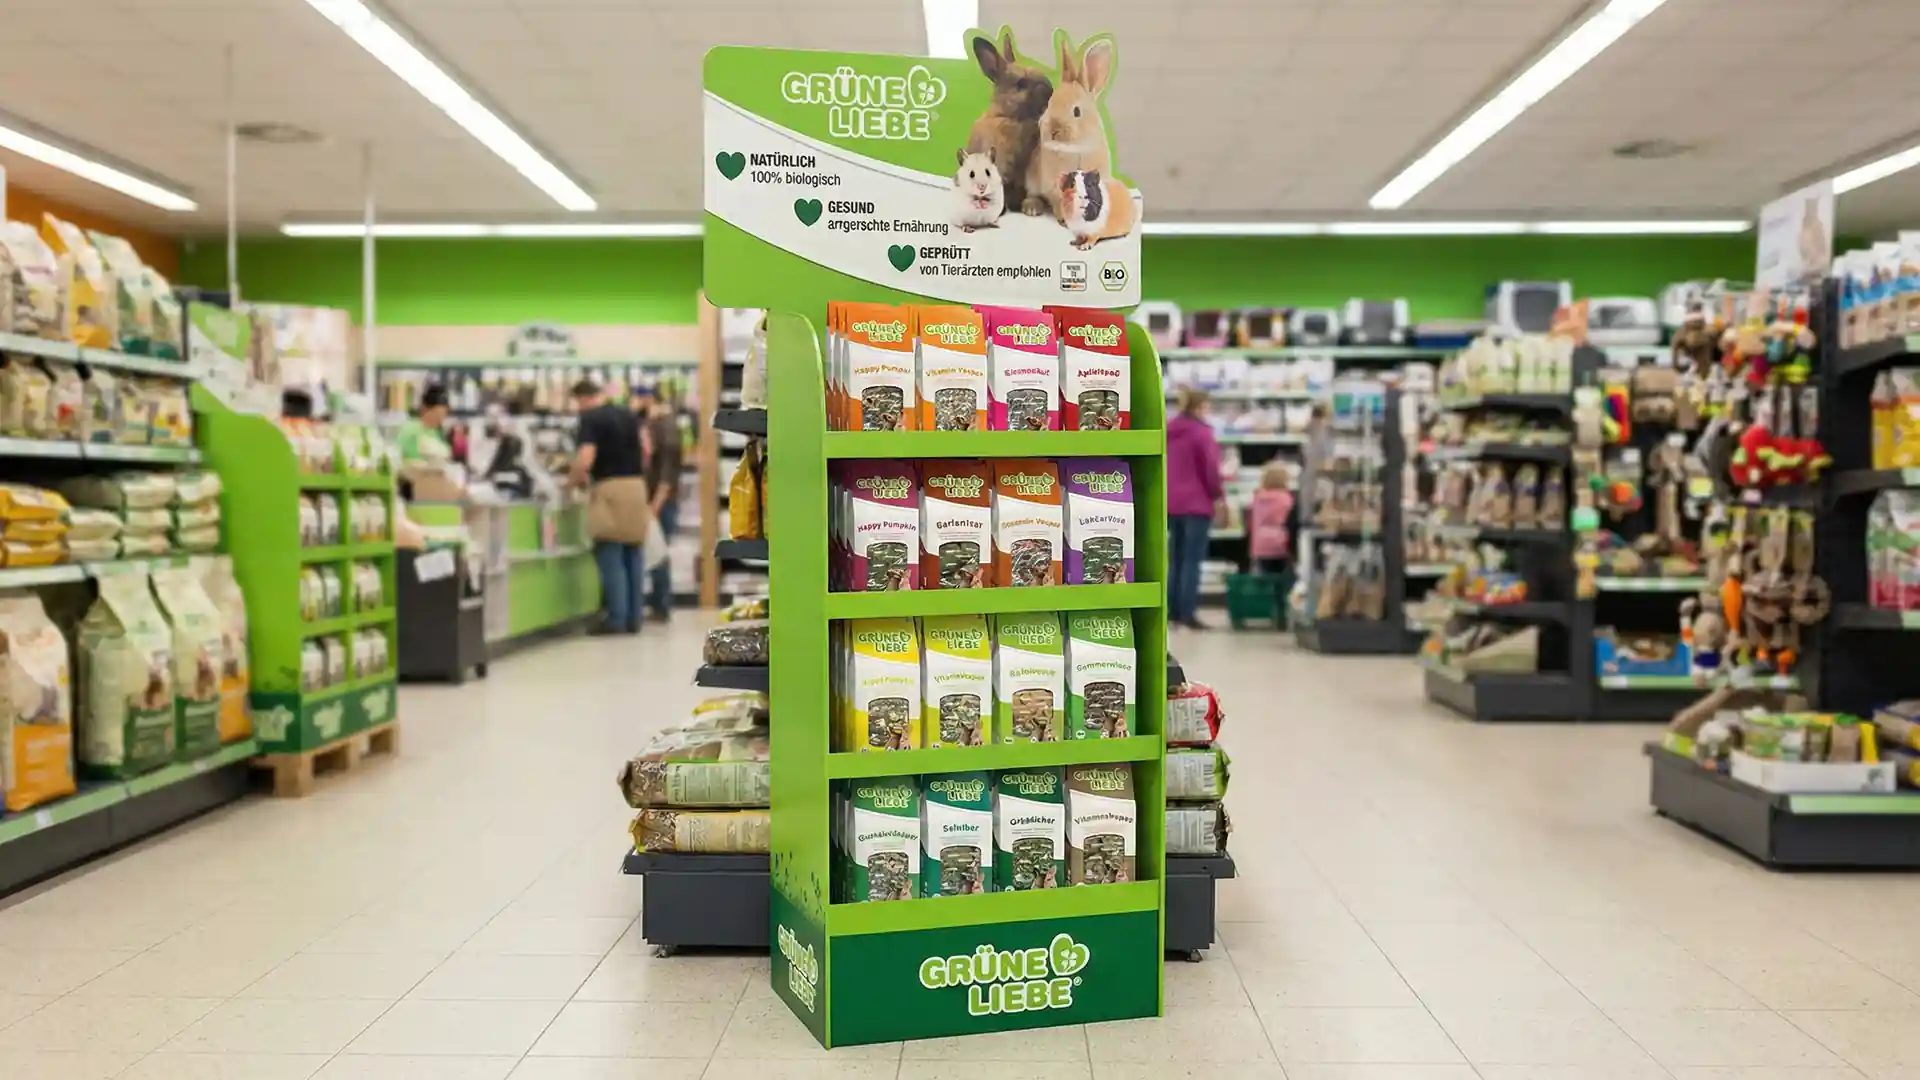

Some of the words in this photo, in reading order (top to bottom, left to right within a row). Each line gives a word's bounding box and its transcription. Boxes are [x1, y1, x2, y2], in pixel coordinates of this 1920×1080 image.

[782, 66, 906, 107] GRÜNE
[830, 106, 930, 140] LIEBE
[750, 152, 816, 168] NATÜRLICH
[750, 171, 782, 184] 100%
[786, 172, 841, 188] biologisch
[828, 200, 875, 214] GESUND
[920, 265, 939, 276] von
[941, 263, 994, 277] Tierärzten
[857, 522, 882, 533] Happy
[883, 521, 917, 531] Pumpkin
[919, 944, 1048, 989] GRÜNE
[968, 977, 1072, 1016] LIEBE
